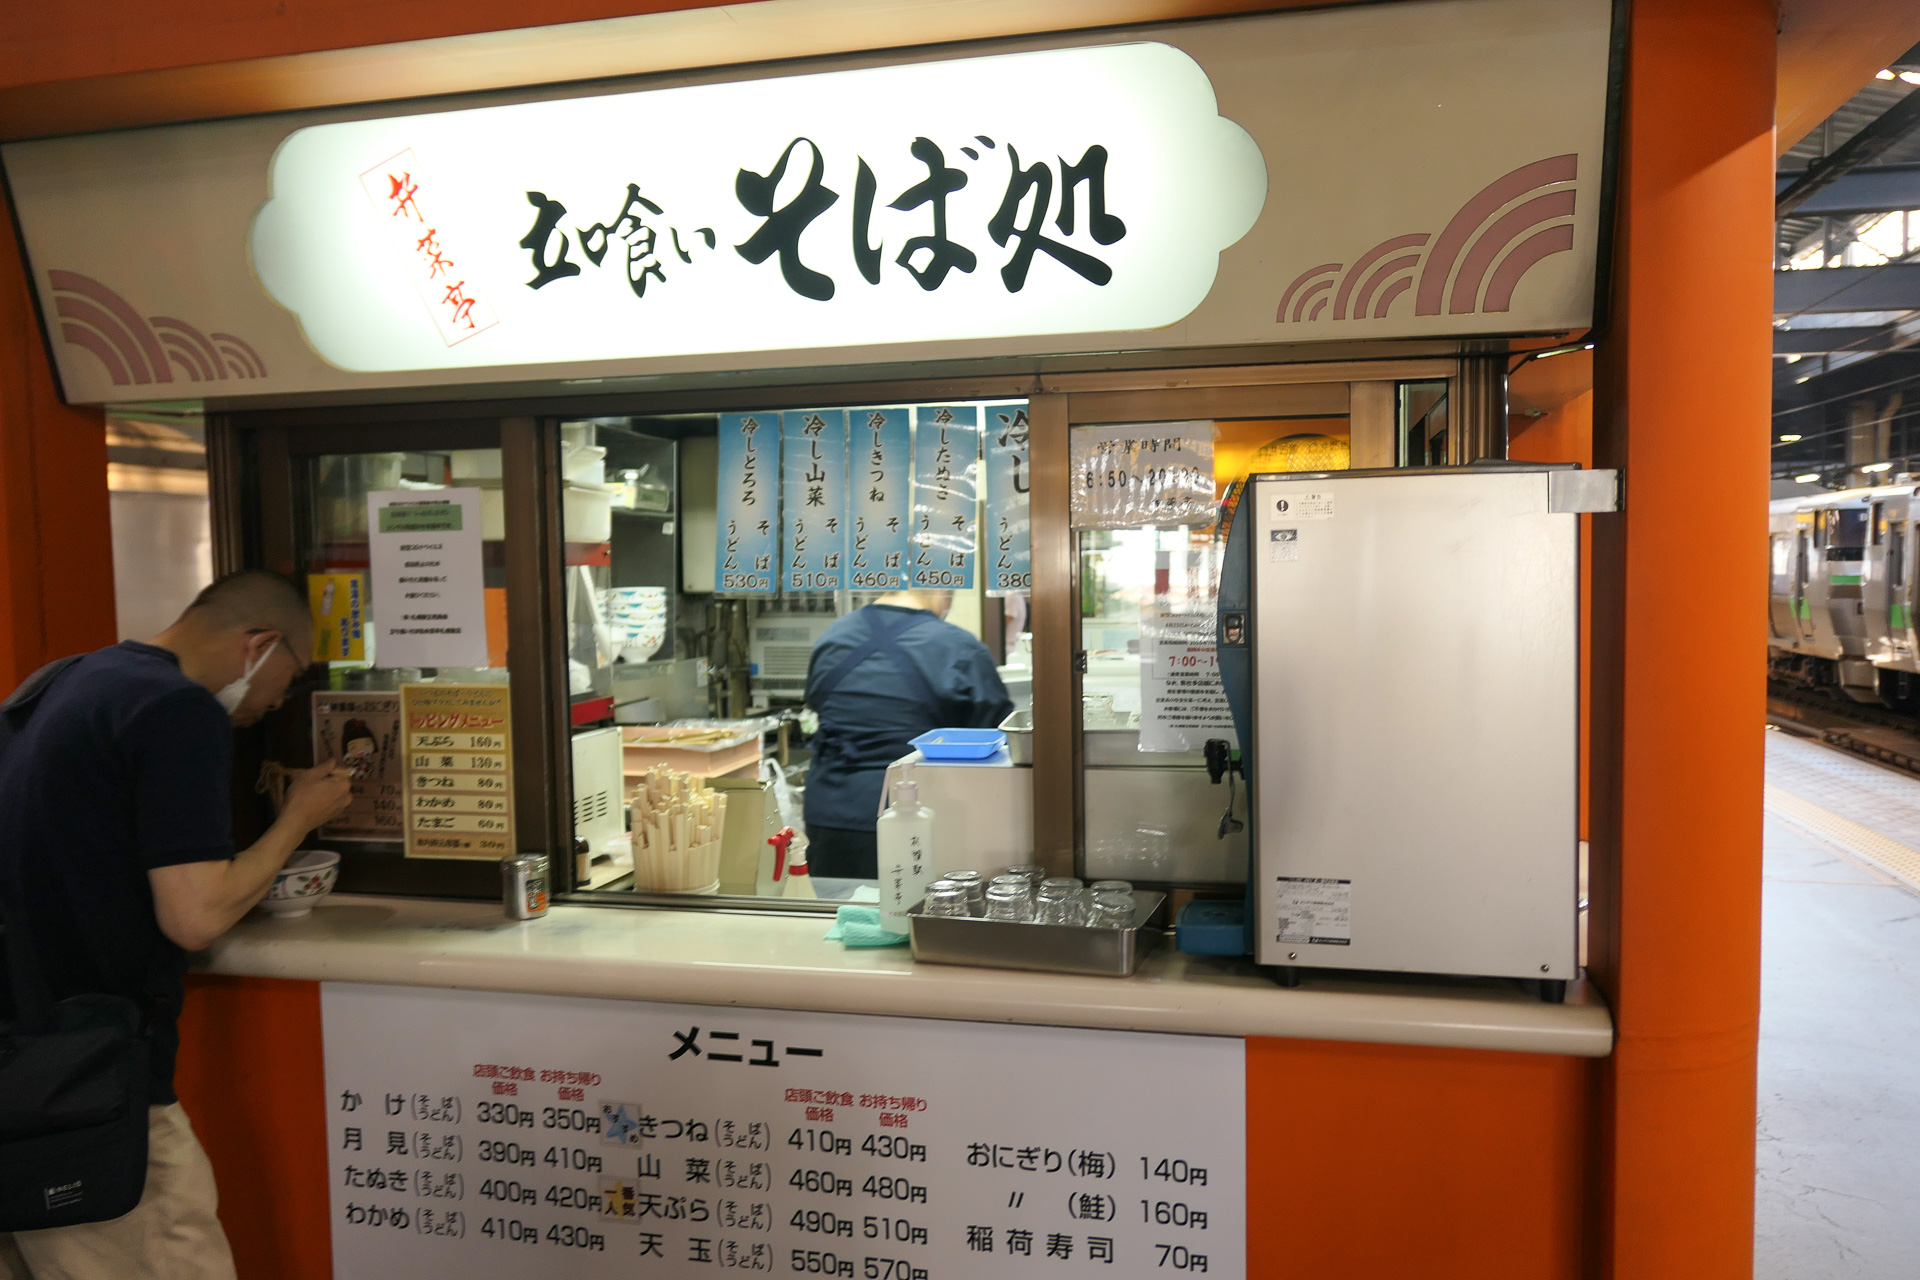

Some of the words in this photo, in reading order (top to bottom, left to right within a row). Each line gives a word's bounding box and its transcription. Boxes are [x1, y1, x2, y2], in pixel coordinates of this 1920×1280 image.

[740, 416, 759, 507] 冷しとろろ
[803, 413, 827, 507] 冷し山菜
[867, 411, 887, 503] 冷しきつね
[724, 519, 741, 570] うどん
[755, 519, 771, 571] そば
[792, 518, 807, 570] うどん
[824, 517, 840, 569] そば
[852, 516, 867, 568] うどん
[885, 516, 900, 568] そば
[950, 514, 966, 567] そば
[997, 516, 1013, 569] うどん
[723, 573, 769, 589] 530円
[791, 572, 838, 588] 510円
[852, 571, 899, 588] 460円
[915, 571, 964, 587] 450円
[416, 736, 454, 748] 天ぷら
[416, 776, 454, 788] きつね
[415, 796, 455, 808] わかめ
[416, 816, 455, 829] たまご
[668, 1026, 824, 1068] メニュー
[473, 1063, 536, 1082] 店頭ご飲食
[539, 1069, 602, 1087] お持ち帰り
[492, 1081, 518, 1097] 価格
[557, 1086, 584, 1102] 価格
[784, 1087, 855, 1107] 店頭ご飲食
[859, 1093, 928, 1113] お持ち帰り
[477, 1101, 535, 1128] 330円
[542, 1107, 601, 1134] 350円
[805, 1106, 834, 1123] 価格
[879, 1111, 909, 1129] 価格
[638, 1115, 709, 1143] きつね
[787, 1128, 852, 1155] 410円
[861, 1134, 927, 1162] 430円
[478, 1140, 536, 1167] 390円
[543, 1146, 603, 1173] 410円
[1140, 1156, 1208, 1187] 140円
[344, 1164, 409, 1192] たぬき
[479, 1179, 537, 1206] 400円
[545, 1185, 603, 1212] 420円
[789, 1169, 853, 1197] 460円
[862, 1176, 927, 1204] 480円
[346, 1202, 410, 1230] わかめ
[481, 1217, 538, 1245] 410円
[546, 1224, 605, 1251] 430円
[638, 1193, 710, 1222] 天ぷら
[790, 1209, 854, 1237] 490円
[863, 1216, 928, 1245] 510円
[1140, 1200, 1208, 1230] 160円
[791, 1250, 855, 1278] 550円
[864, 1257, 929, 1280] 570円
[1155, 1243, 1208, 1273] 70円
